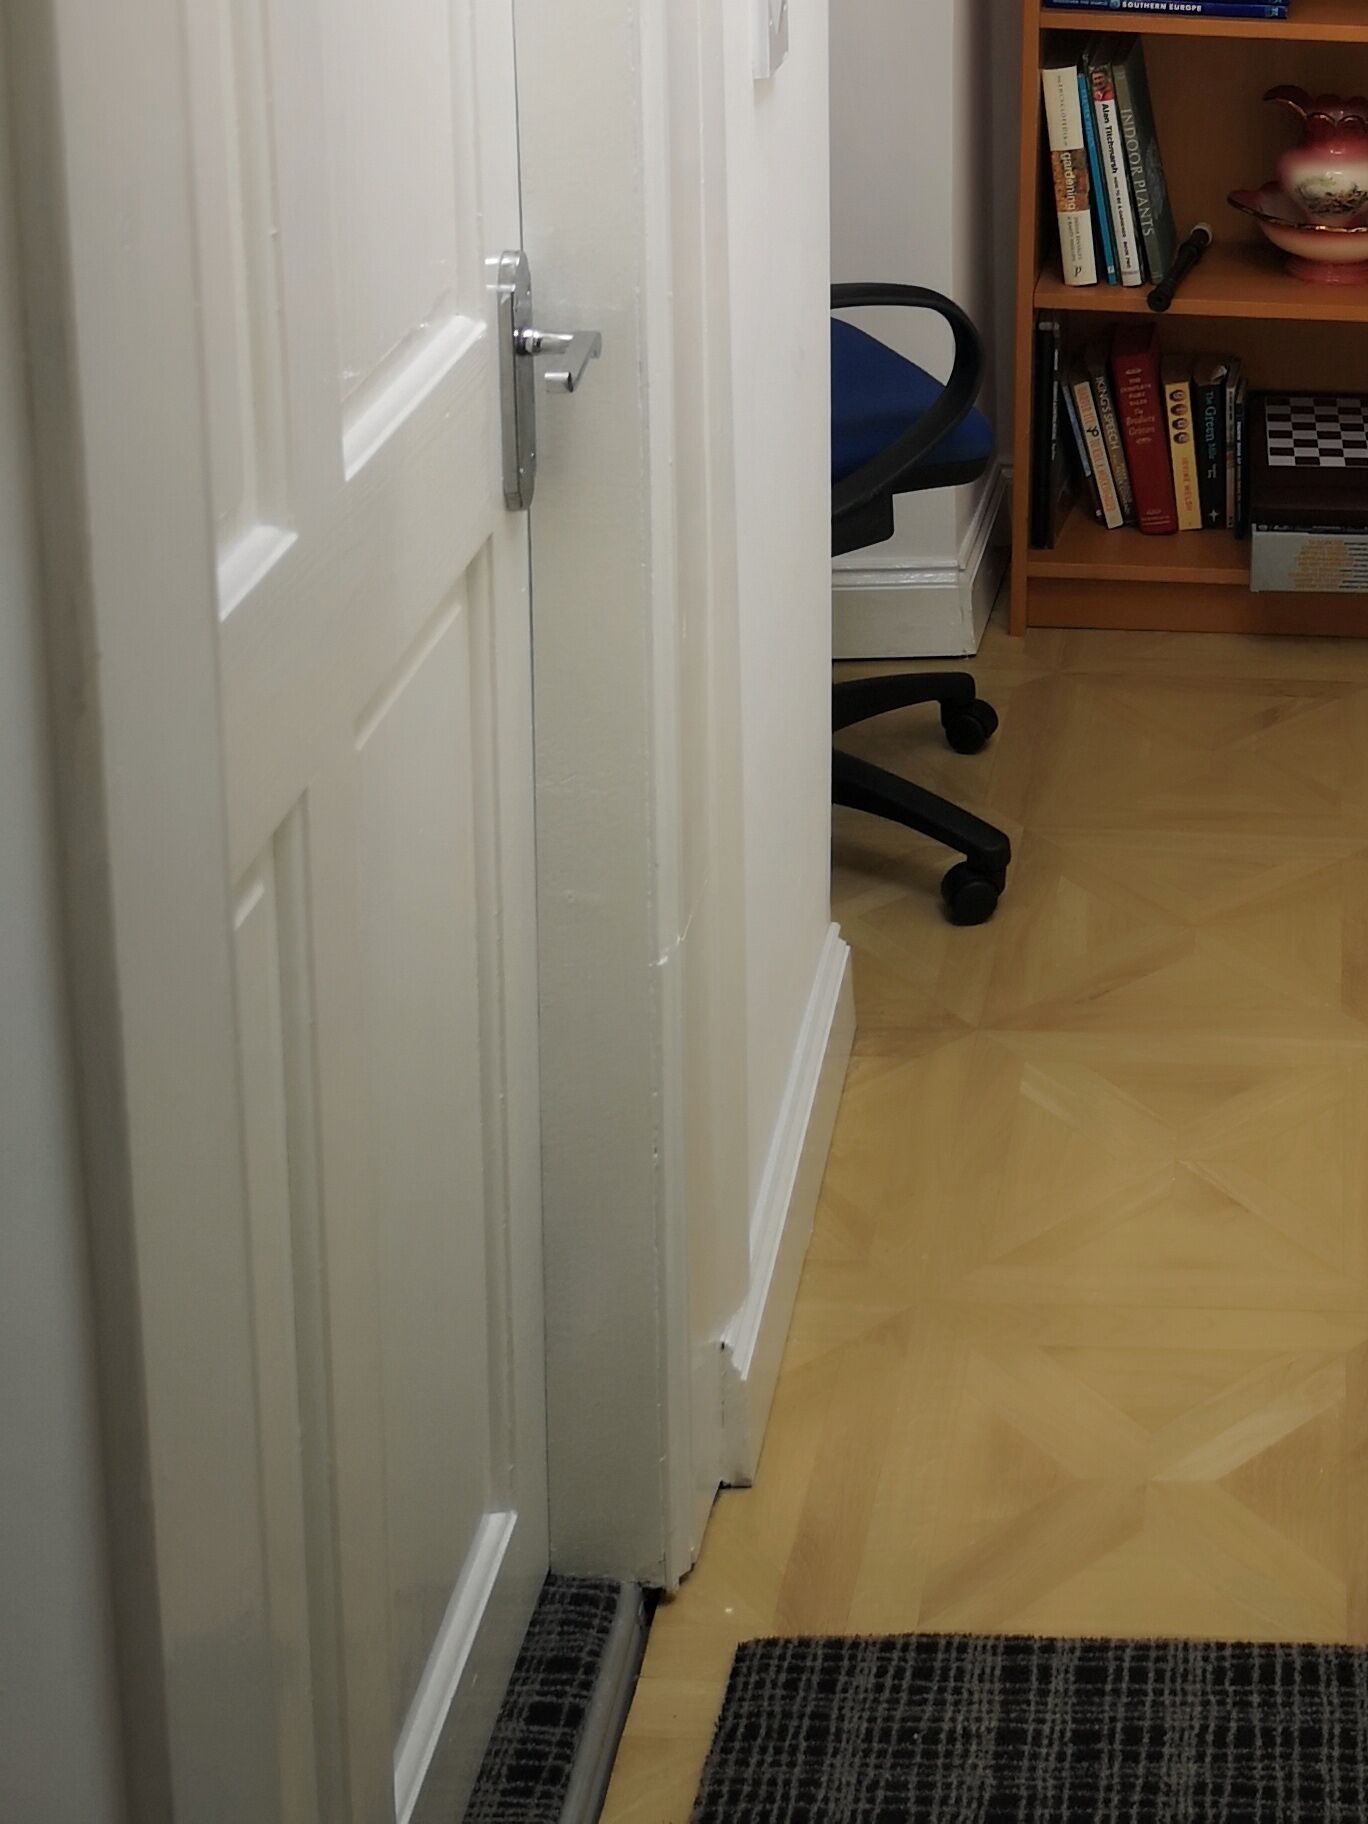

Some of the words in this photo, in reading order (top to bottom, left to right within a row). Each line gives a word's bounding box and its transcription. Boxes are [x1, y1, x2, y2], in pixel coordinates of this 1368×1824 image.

[1122, 0, 1166, 10] SOUTHERN
[1169, 2, 1202, 12] EUROPE
[1101, 103, 1110, 124] Alan
[1105, 126, 1118, 173] Titchmarsh
[1059, 151, 1077, 211] gardening
[1120, 108, 1142, 175] INDOOR
[1134, 179, 1154, 236] PLANTS
[1206, 391, 1214, 405] The
[1104, 413, 1119, 450] SPEECH
[1205, 406, 1217, 442] Green
